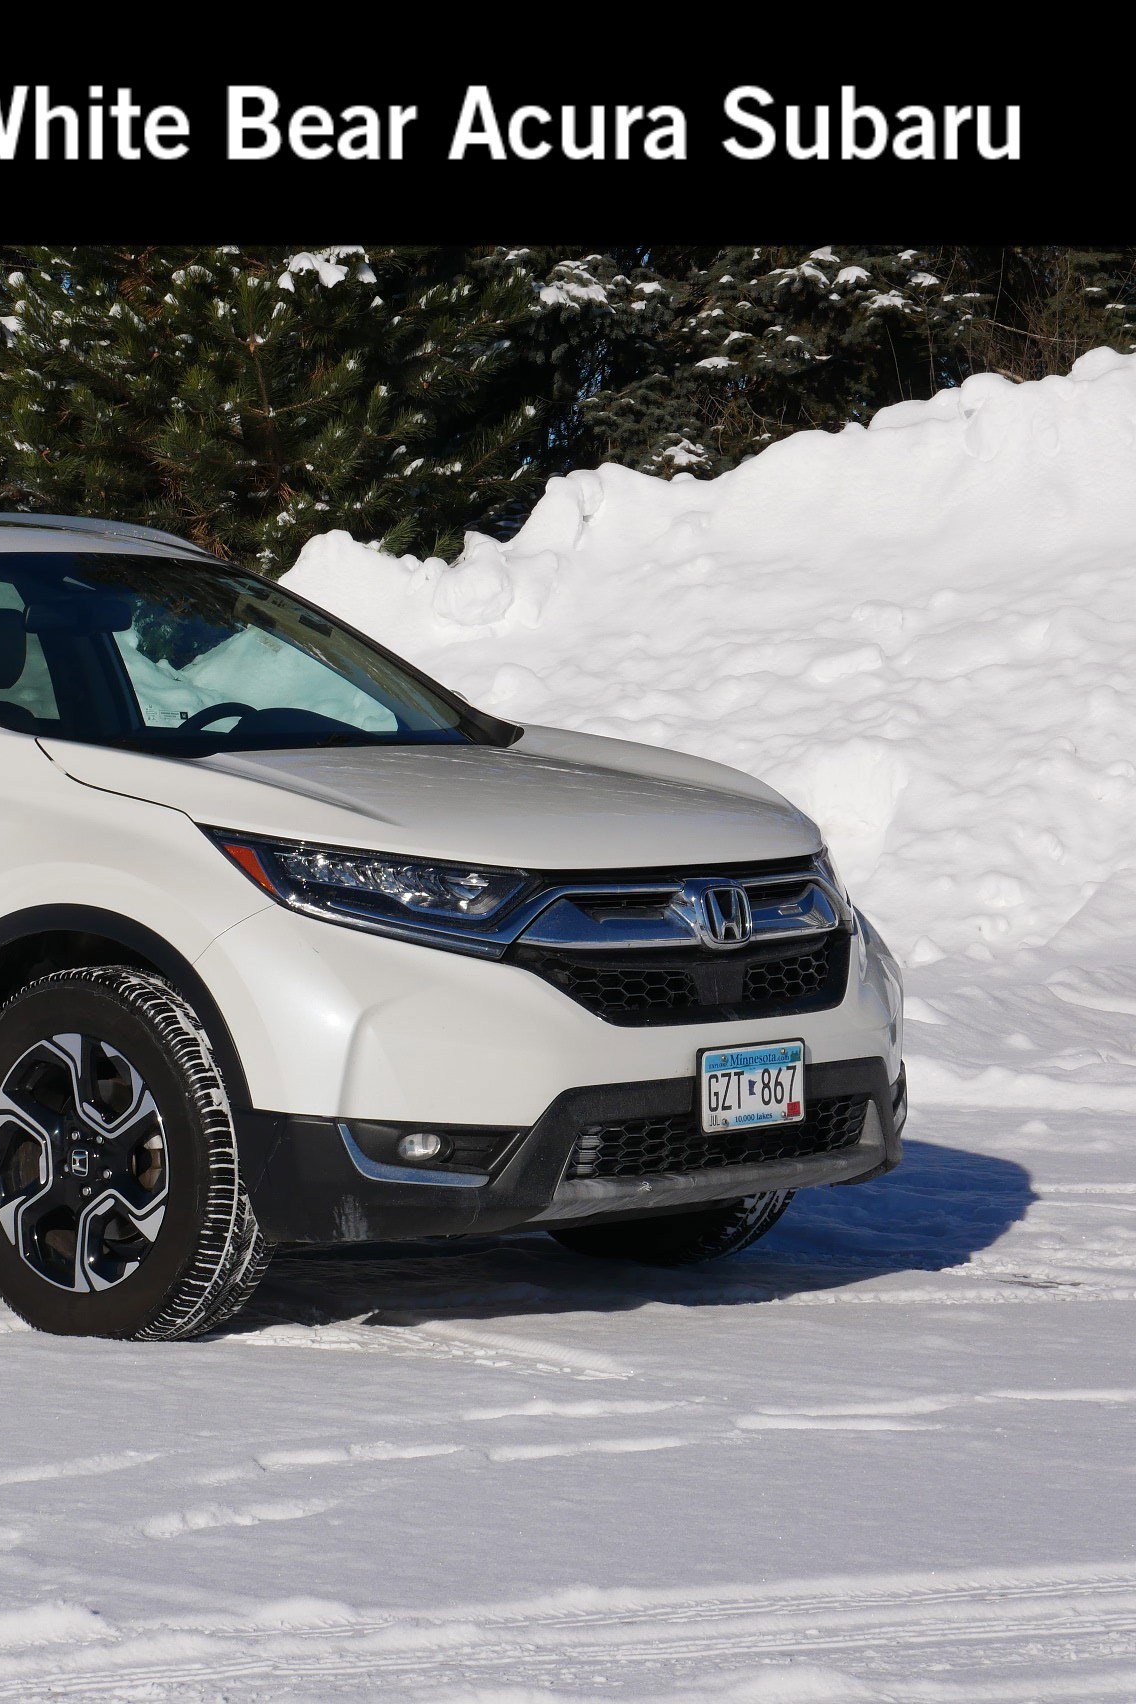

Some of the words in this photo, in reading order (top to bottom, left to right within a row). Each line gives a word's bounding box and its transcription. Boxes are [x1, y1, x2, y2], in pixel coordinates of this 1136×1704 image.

[708, 1071, 745, 1112] GZT
[761, 1065, 797, 1106] 867
[734, 1114, 755, 1123] 10,000
[756, 1112, 773, 1121] lakes
